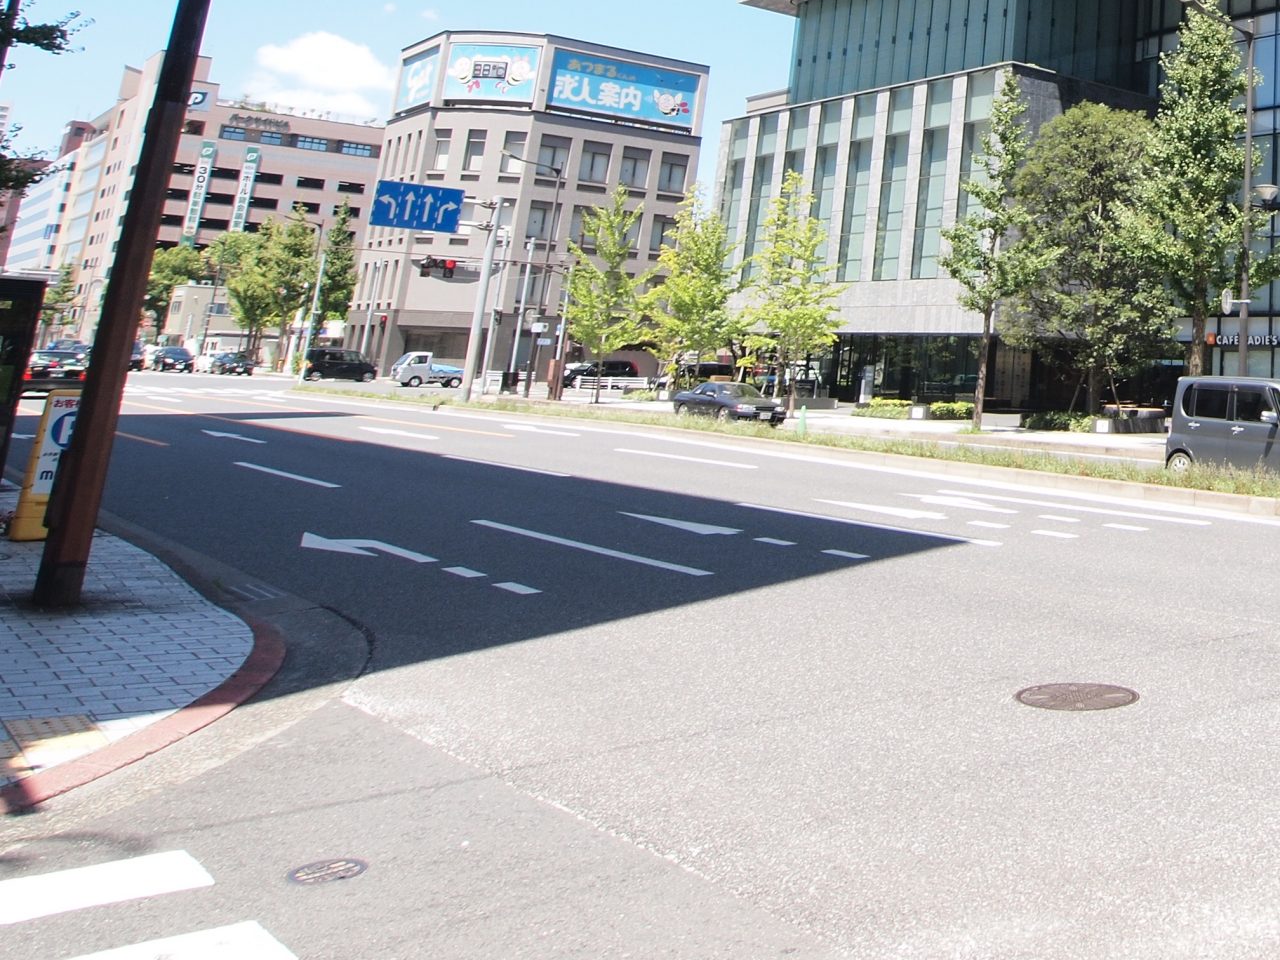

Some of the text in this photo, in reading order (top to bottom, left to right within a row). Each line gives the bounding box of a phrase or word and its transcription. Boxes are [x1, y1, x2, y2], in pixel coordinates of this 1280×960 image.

[553, 74, 643, 112] 求人案内
[1247, 334, 1278, 345] ADIE'S
[53, 399, 80, 409] お客
